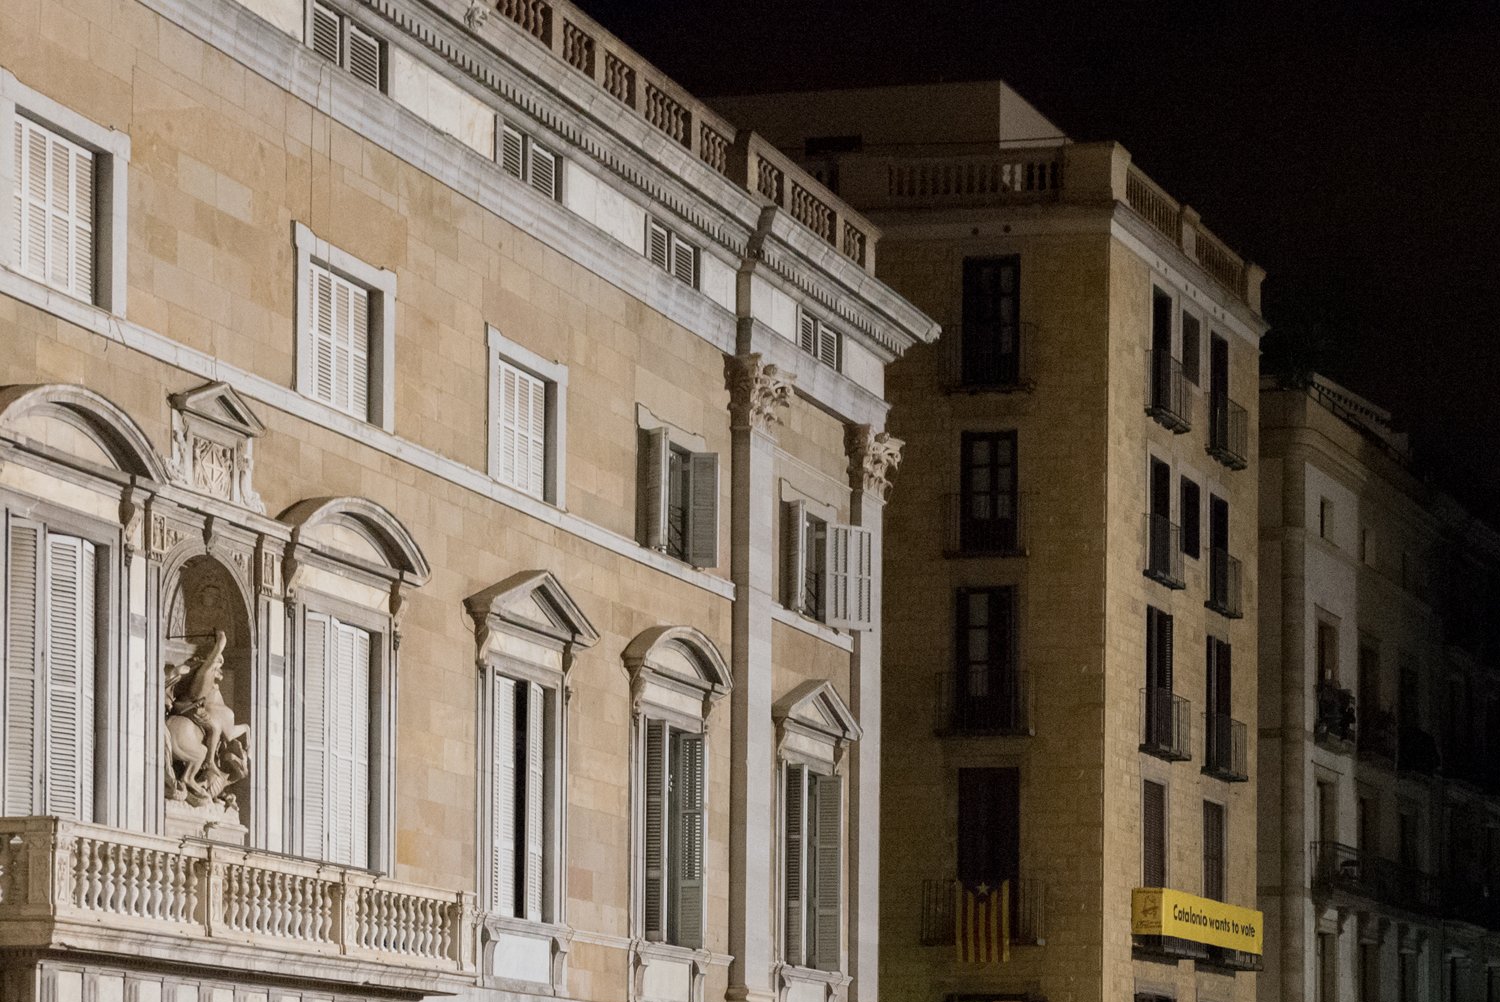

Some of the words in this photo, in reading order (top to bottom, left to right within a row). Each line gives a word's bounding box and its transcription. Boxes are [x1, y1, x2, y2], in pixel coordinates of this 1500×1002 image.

[1173, 904, 1207, 927] Catalonia
[1208, 917, 1231, 933] wants
[1231, 919, 1239, 934] to
[1240, 924, 1256, 938] vote
